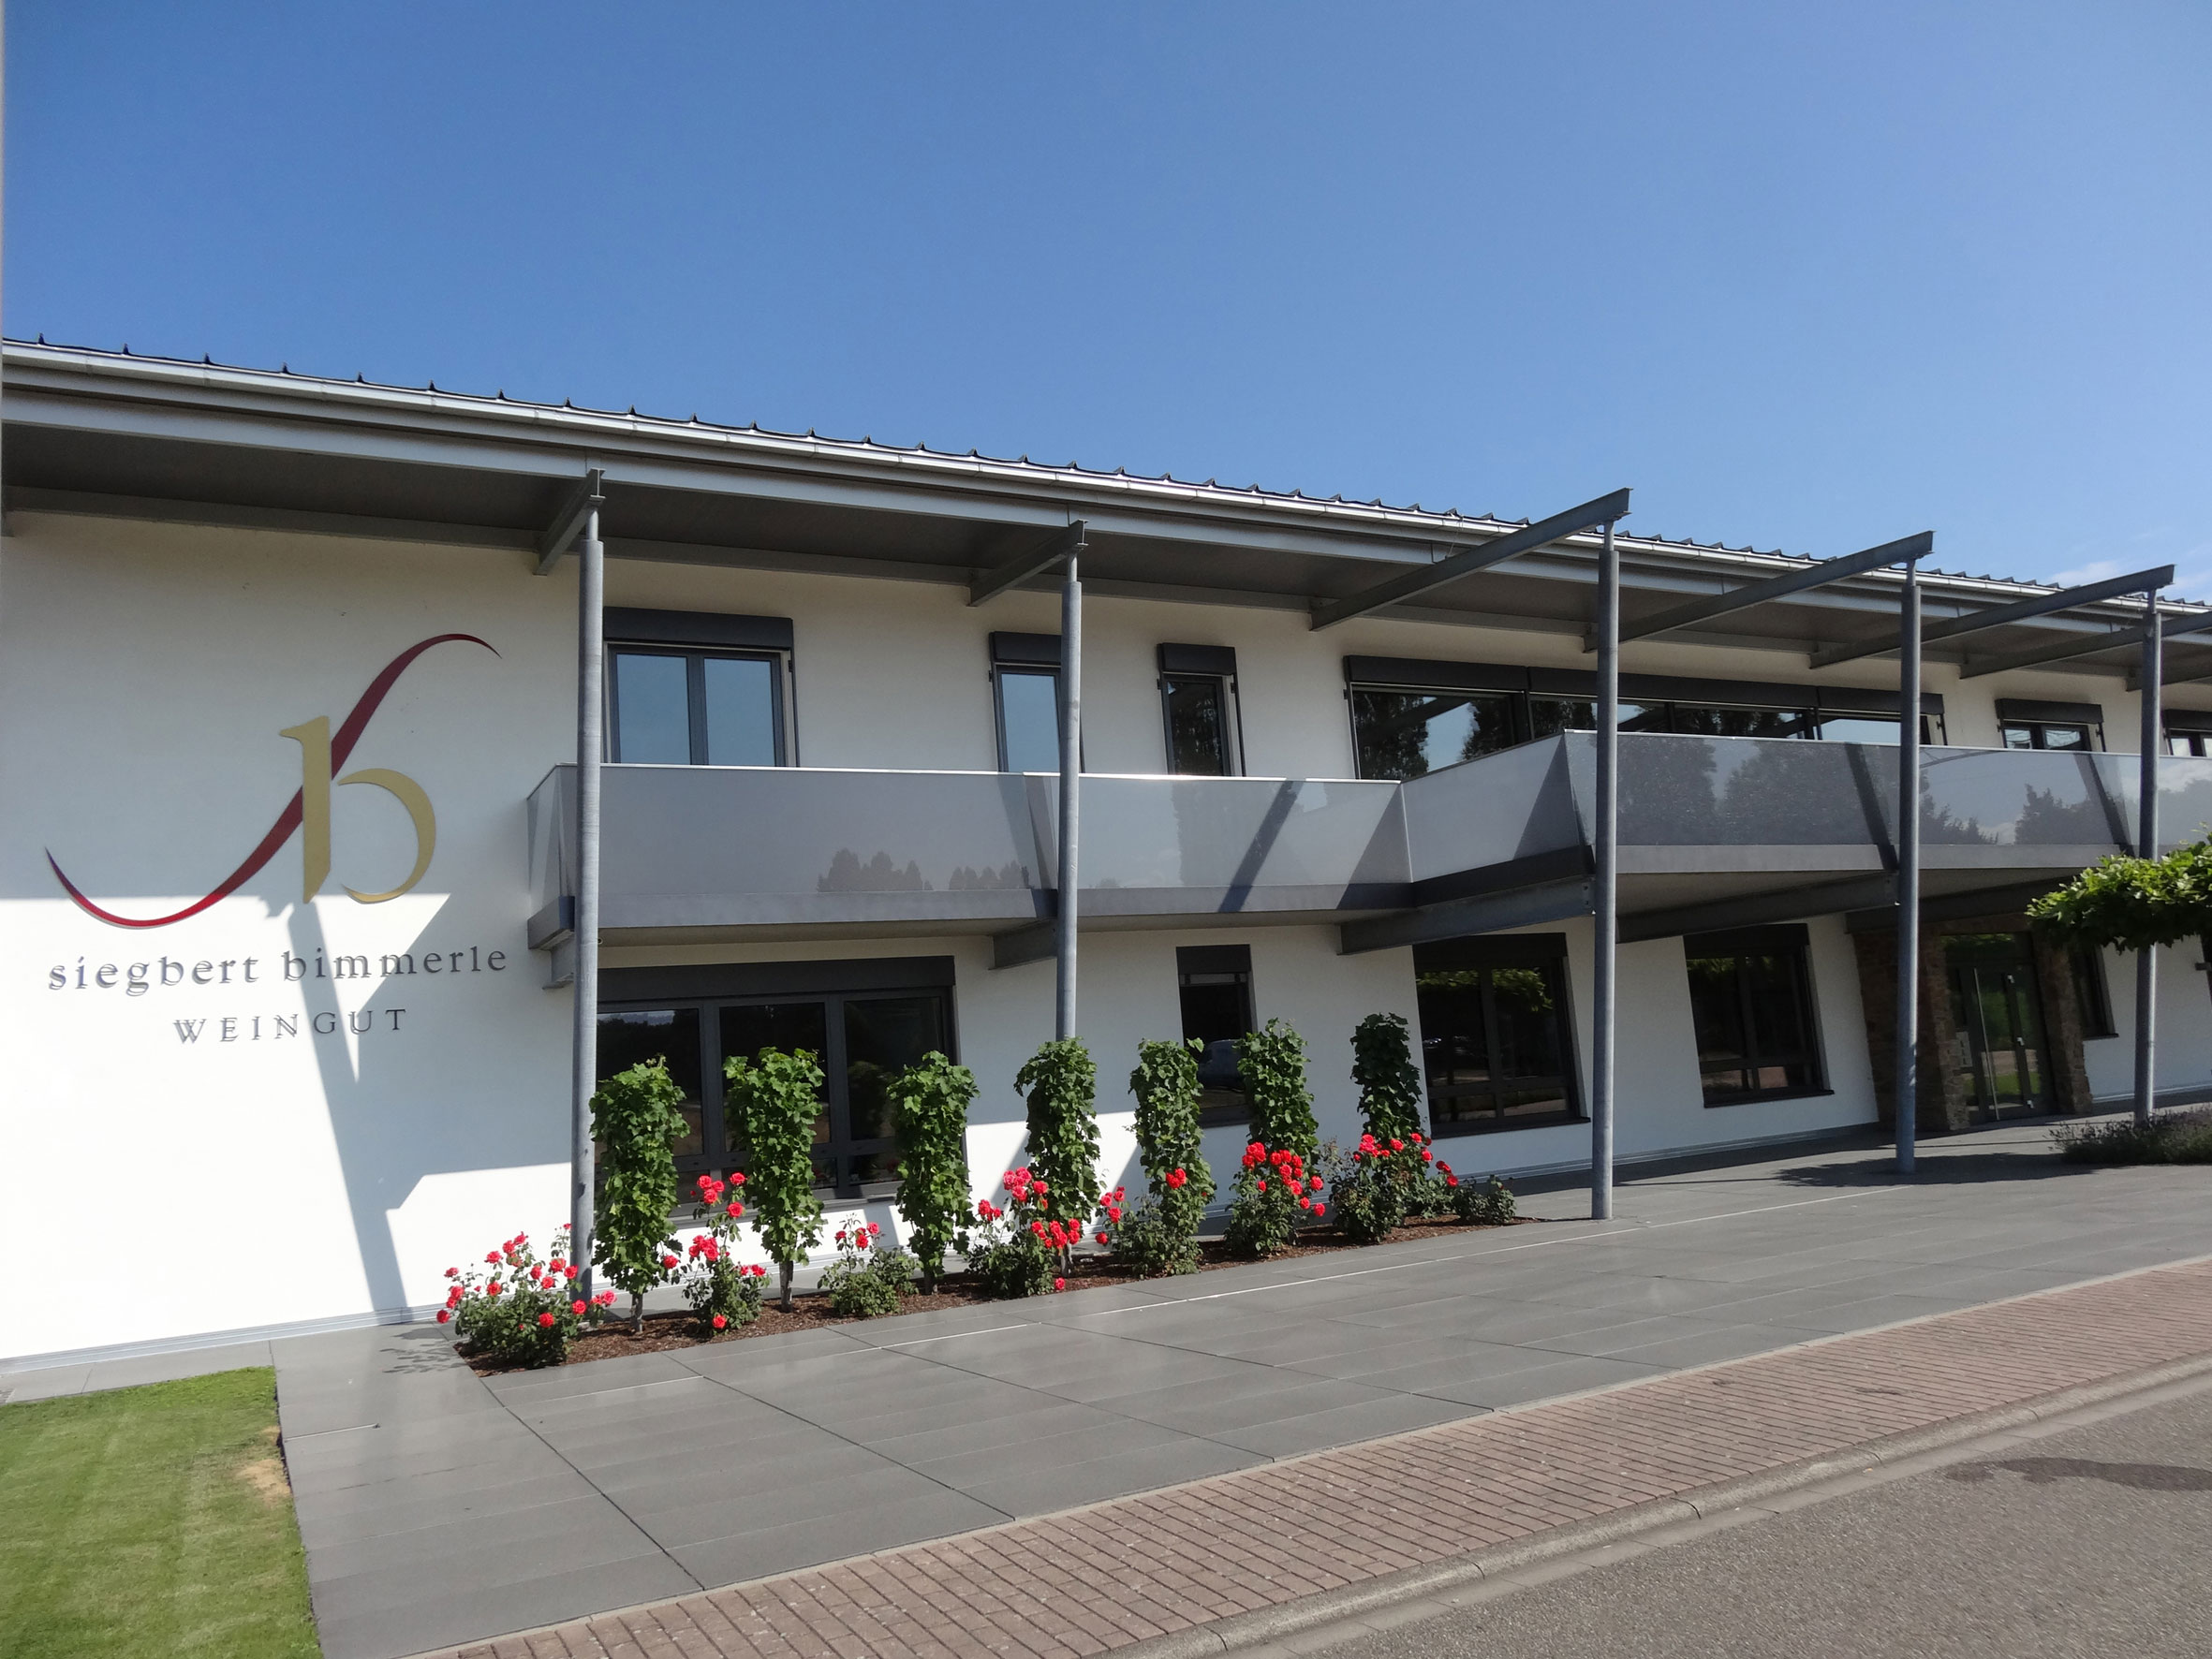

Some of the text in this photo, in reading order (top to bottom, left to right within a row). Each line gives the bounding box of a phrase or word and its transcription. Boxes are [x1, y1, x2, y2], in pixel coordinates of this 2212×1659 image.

[49, 946, 507, 997] siegbert bimmerle
[173, 1009, 406, 1044] WEINGUT
